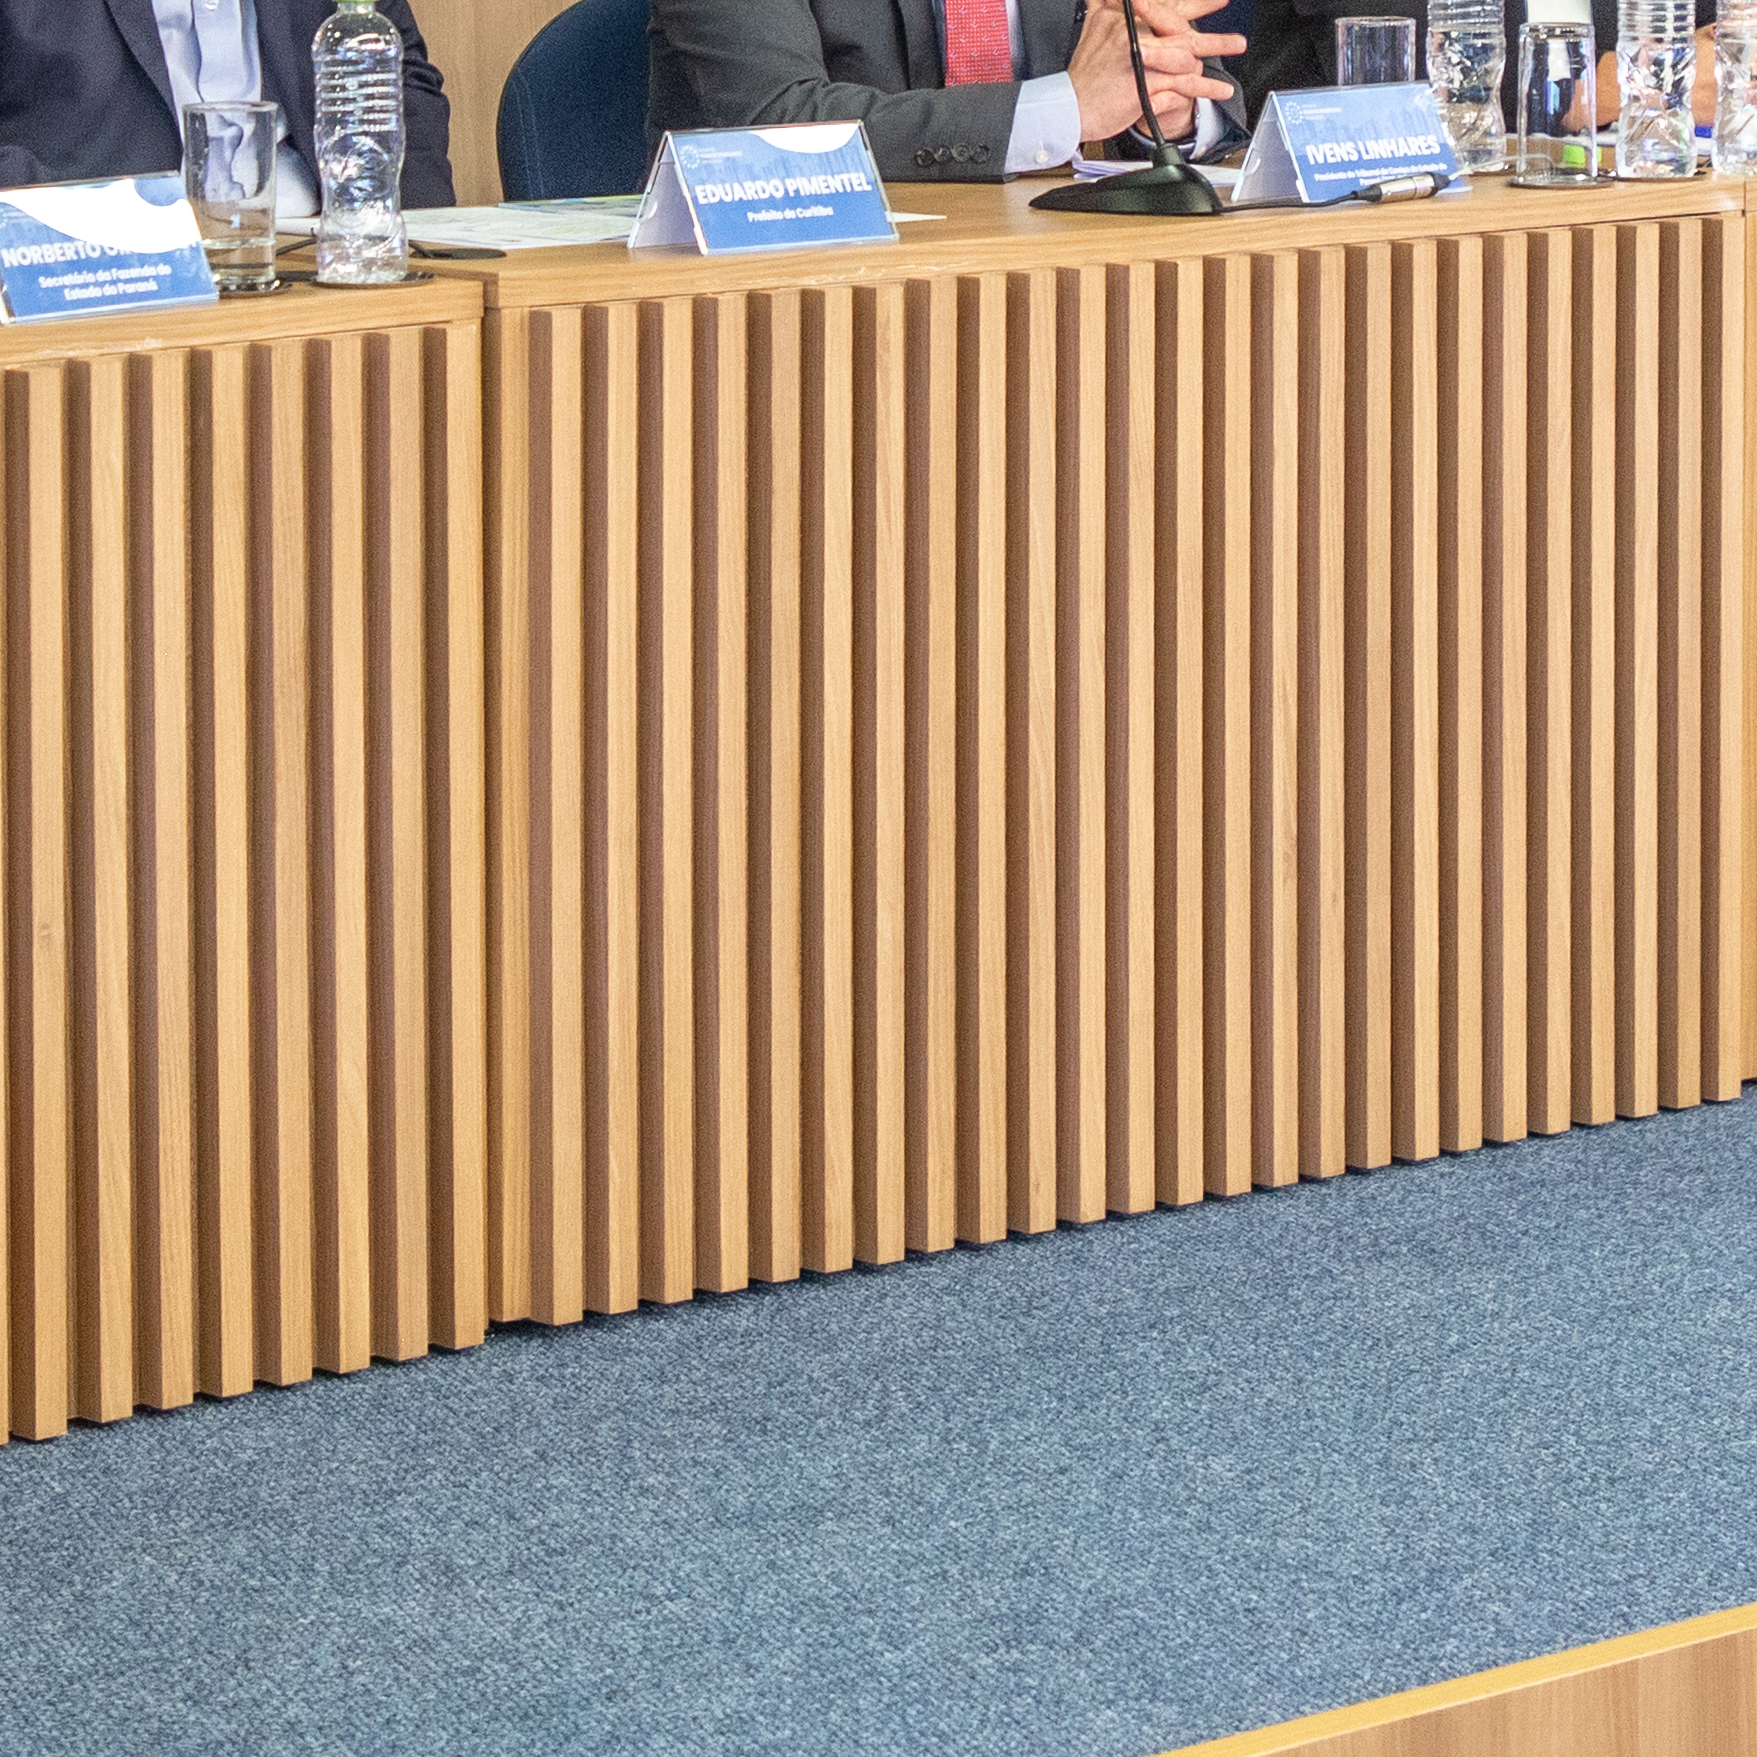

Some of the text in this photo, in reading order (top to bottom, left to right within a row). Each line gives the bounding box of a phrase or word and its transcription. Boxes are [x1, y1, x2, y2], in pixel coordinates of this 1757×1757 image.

[1306, 135, 1441, 165] IVENS LINHARES
[695, 172, 872, 205] EDUARDO PIMENTEL
[0, 241, 100, 268] NORBERTO
[38, 263, 172, 289] Secretário da Fazenda do
[64, 278, 159, 301] Estado do Paraná
